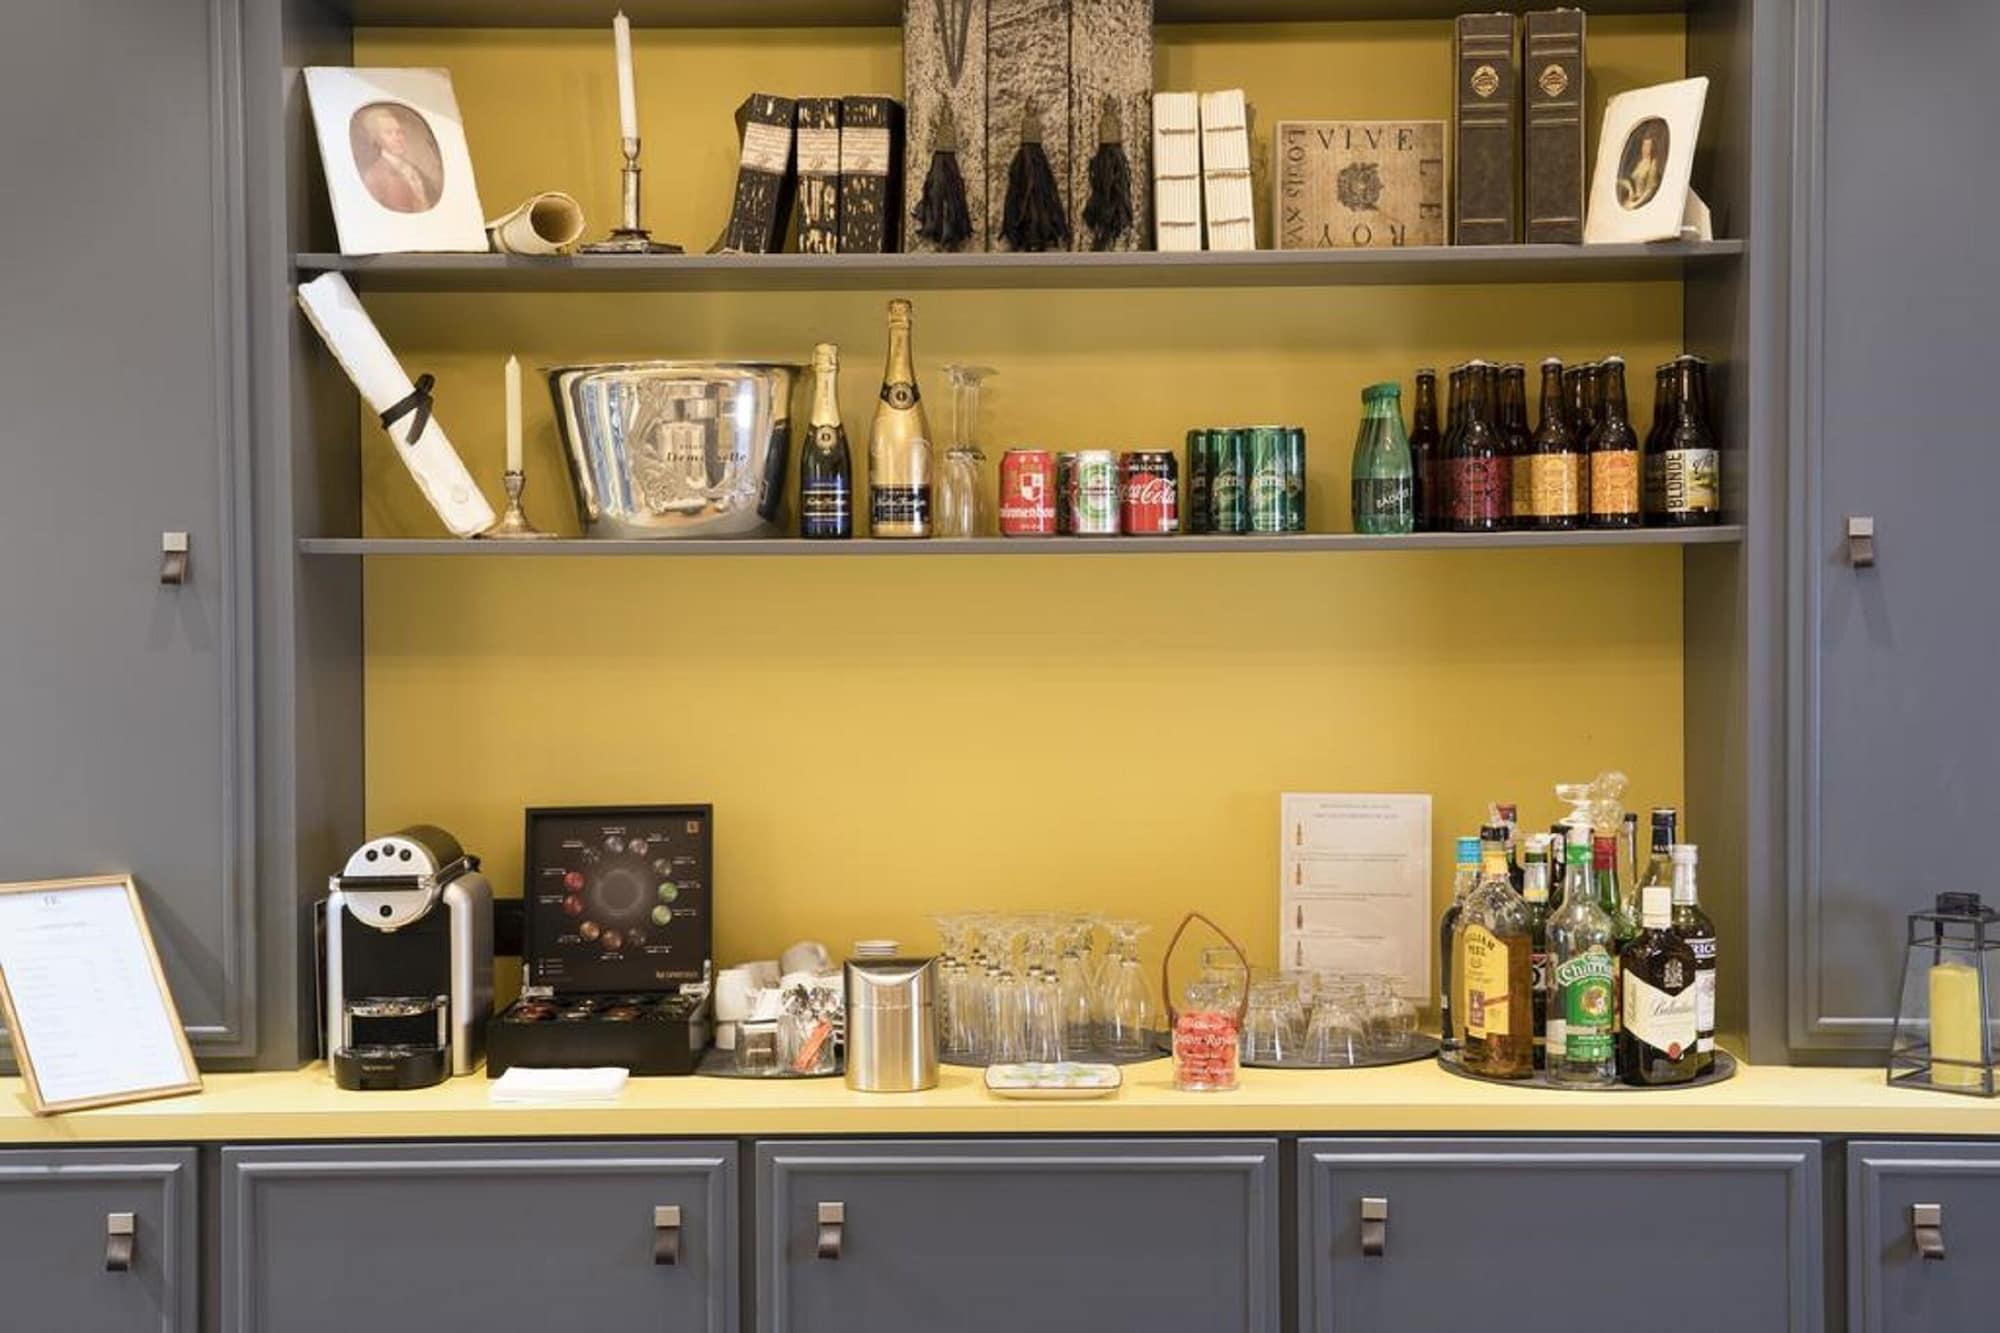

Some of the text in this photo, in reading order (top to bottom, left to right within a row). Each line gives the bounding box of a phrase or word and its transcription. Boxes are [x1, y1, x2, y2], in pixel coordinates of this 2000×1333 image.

[1317, 128, 1413, 151] VIVE
[1419, 159, 1443, 220] LE
[1317, 223, 1406, 248] ROY
[1667, 452, 1684, 509] BLONDE
